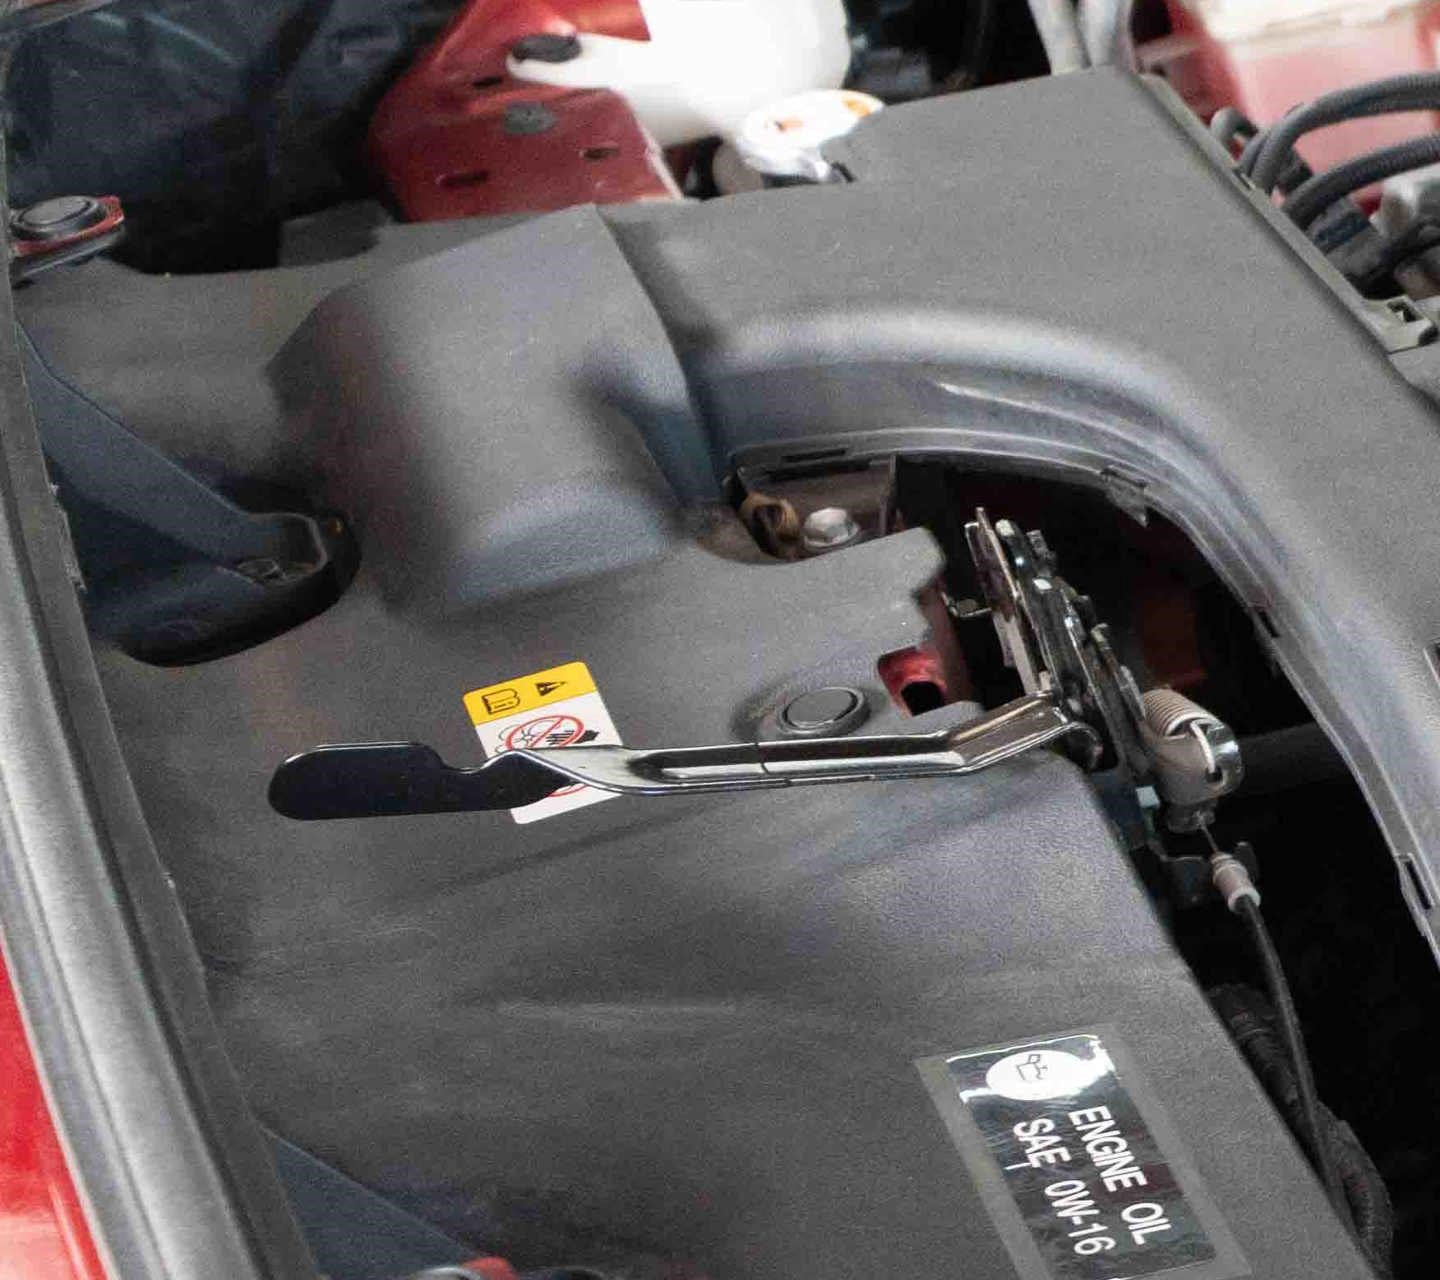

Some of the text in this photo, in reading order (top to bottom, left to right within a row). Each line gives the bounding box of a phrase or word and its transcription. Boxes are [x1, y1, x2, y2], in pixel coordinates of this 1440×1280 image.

[1013, 1117, 1117, 1256] SAE 0W-16
[1067, 1104, 1172, 1246] ENGINE OIL
